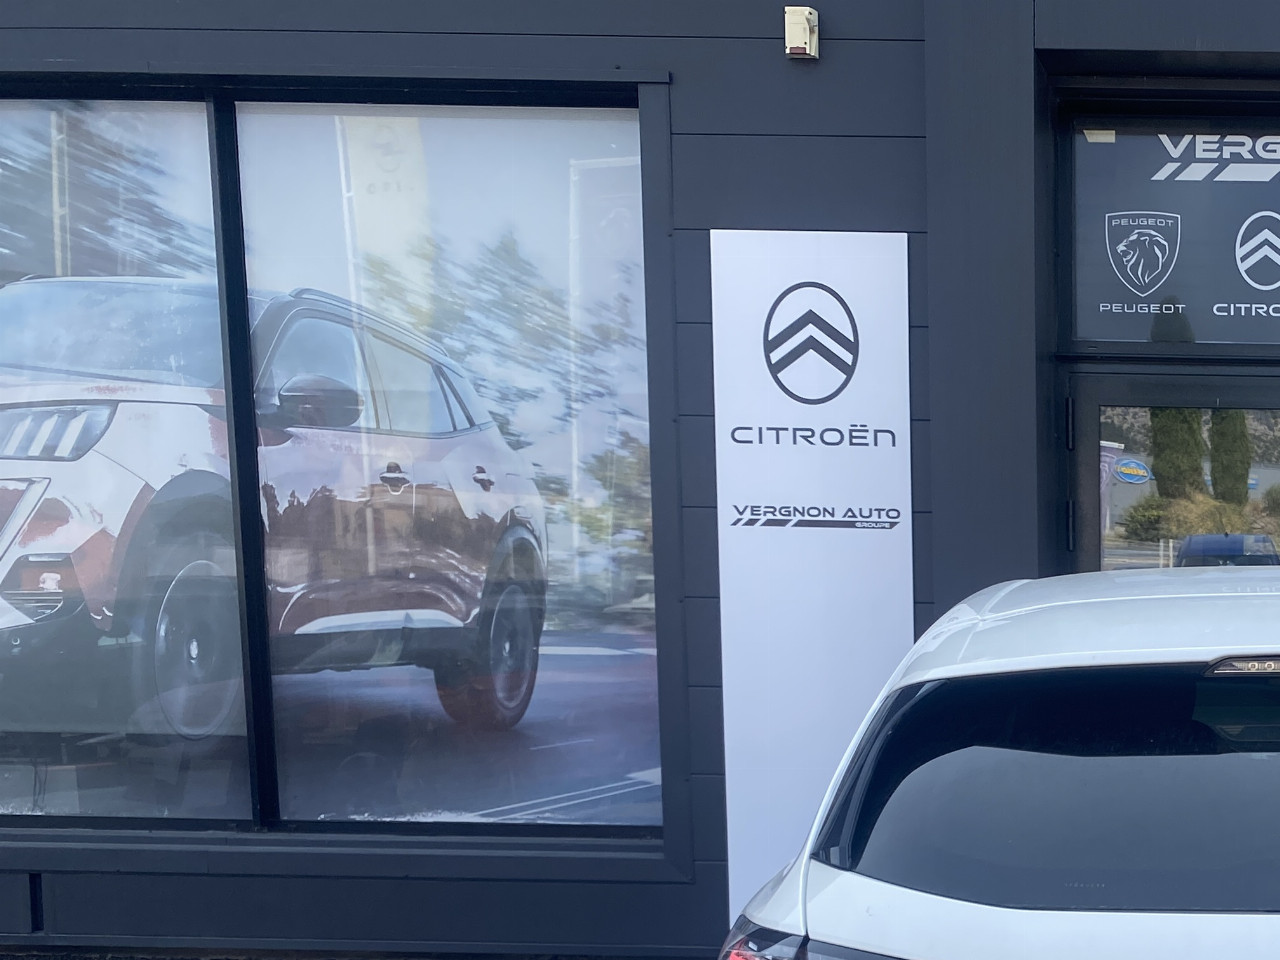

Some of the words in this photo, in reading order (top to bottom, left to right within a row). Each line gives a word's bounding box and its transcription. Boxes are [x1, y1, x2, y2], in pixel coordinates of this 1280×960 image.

[1112, 218, 1174, 228] PEUGEOT
[1100, 303, 1186, 314] PEUGEOT
[732, 504, 835, 518] VERGNON
[842, 507, 901, 519] AUTO
